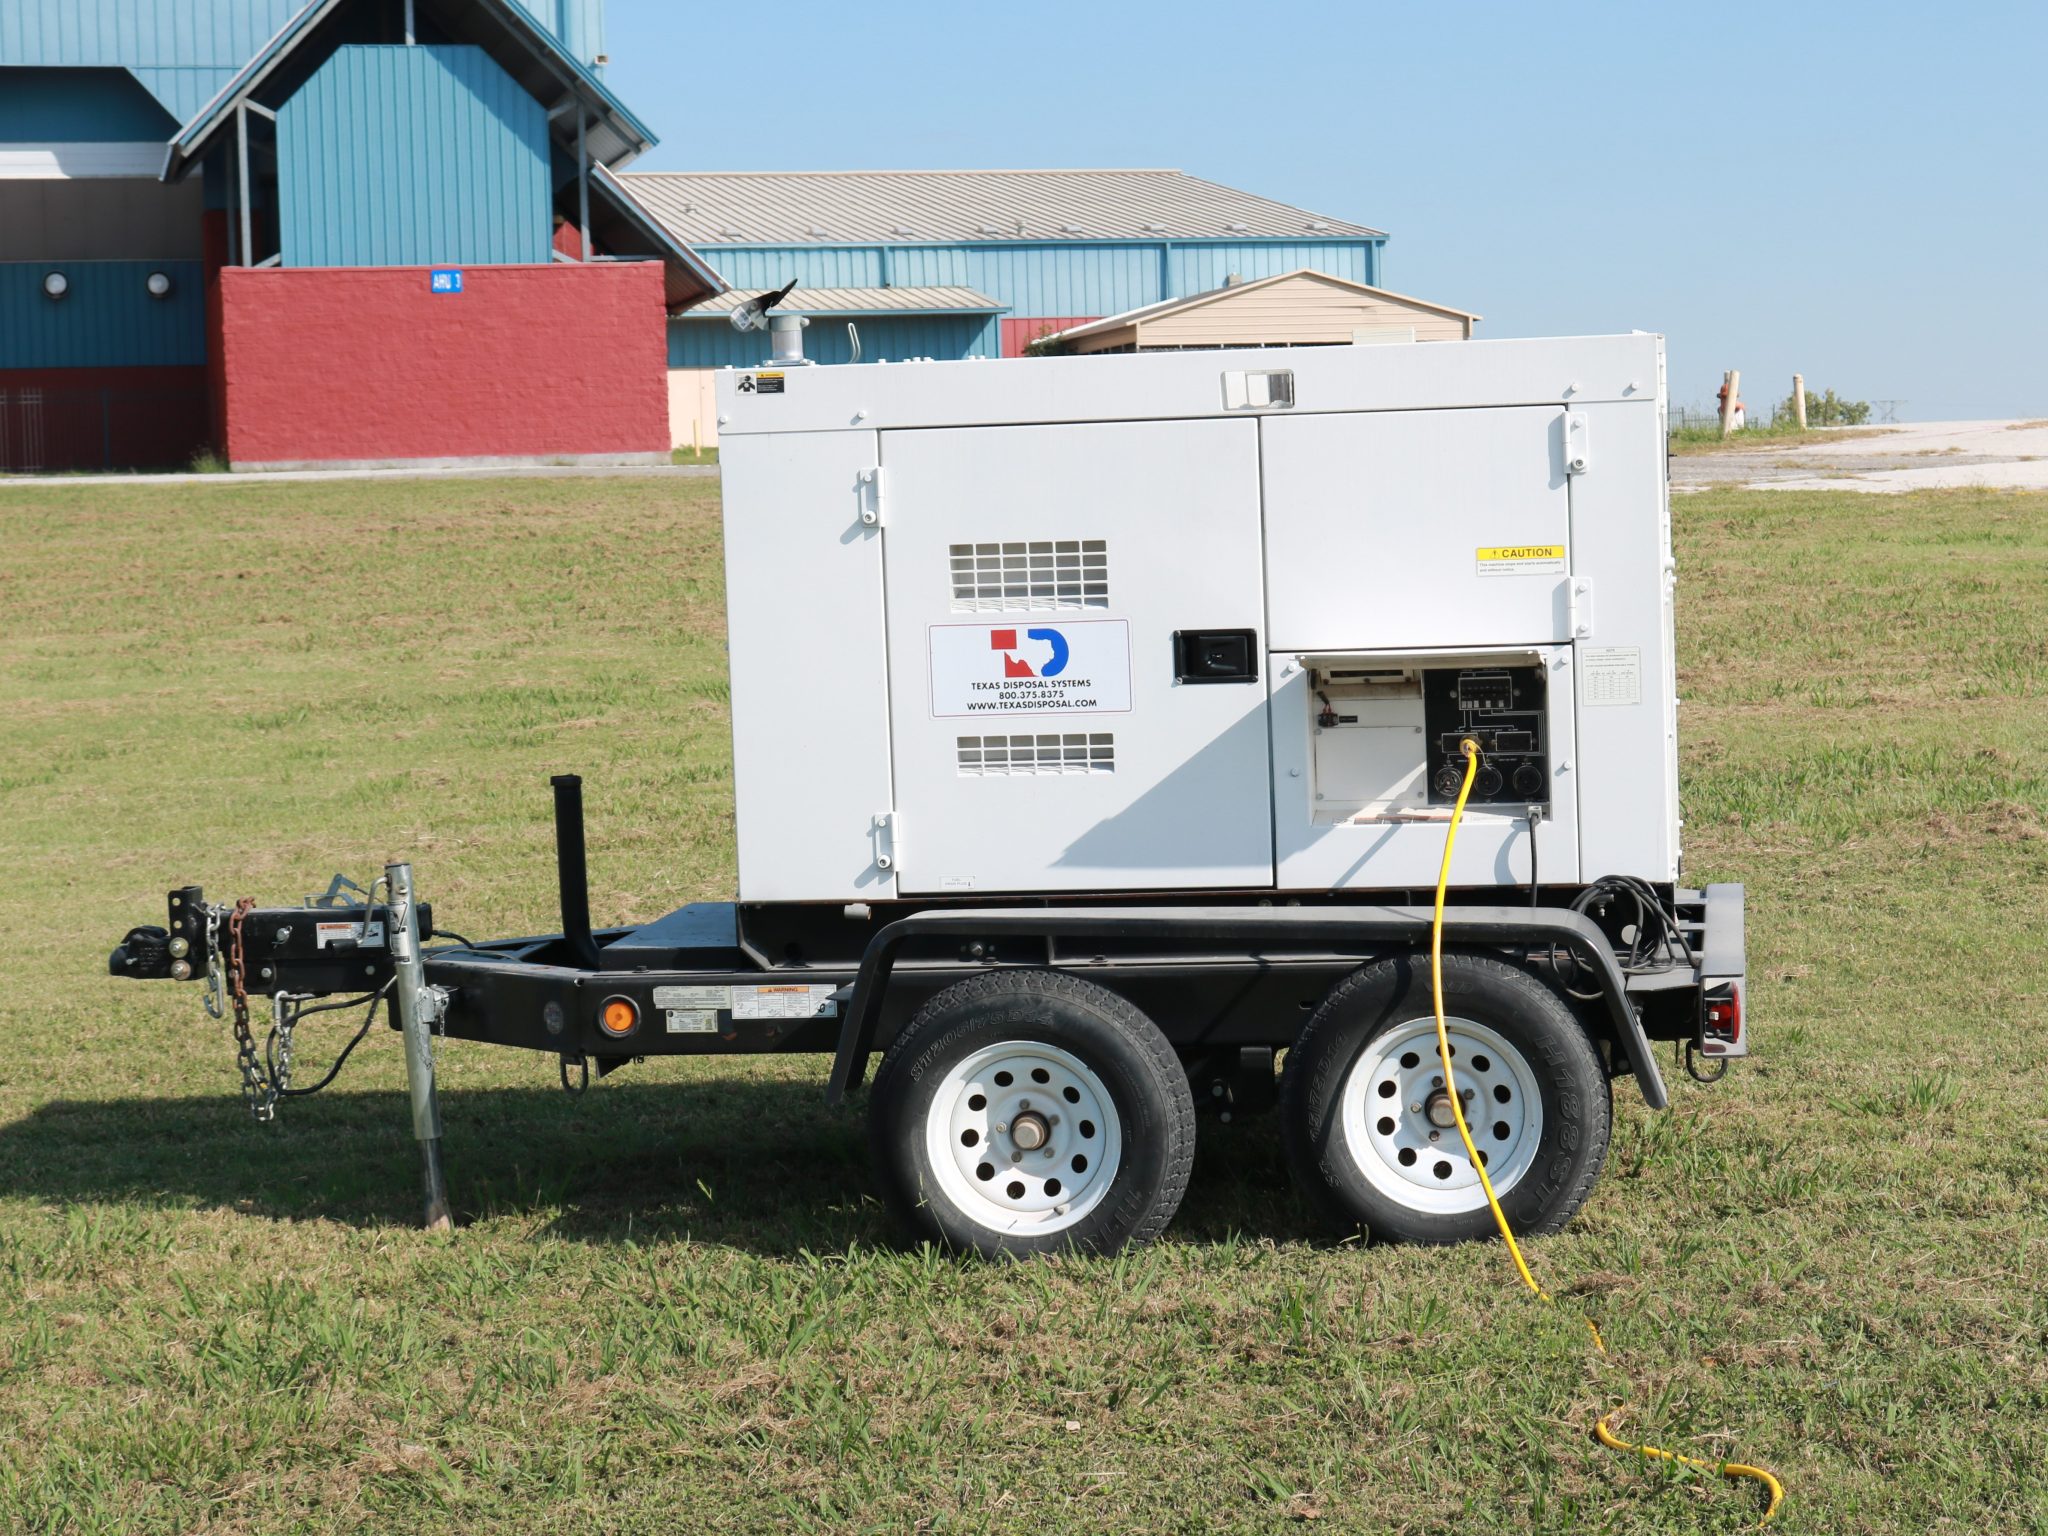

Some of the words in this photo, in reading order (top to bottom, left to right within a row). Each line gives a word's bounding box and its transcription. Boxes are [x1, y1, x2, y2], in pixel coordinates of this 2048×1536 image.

[1502, 548, 1552, 558] CAUTION
[971, 682, 1001, 690] TEXAS
[1003, 681, 1049, 690] DISPOSAL
[1051, 679, 1091, 688] SYSTEMS
[999, 690, 1064, 699] 800.375.8375
[967, 699, 1097, 711] WWW.TEXASDISPOSAL.COM
[1535, 1033, 1581, 1214] H188ST
